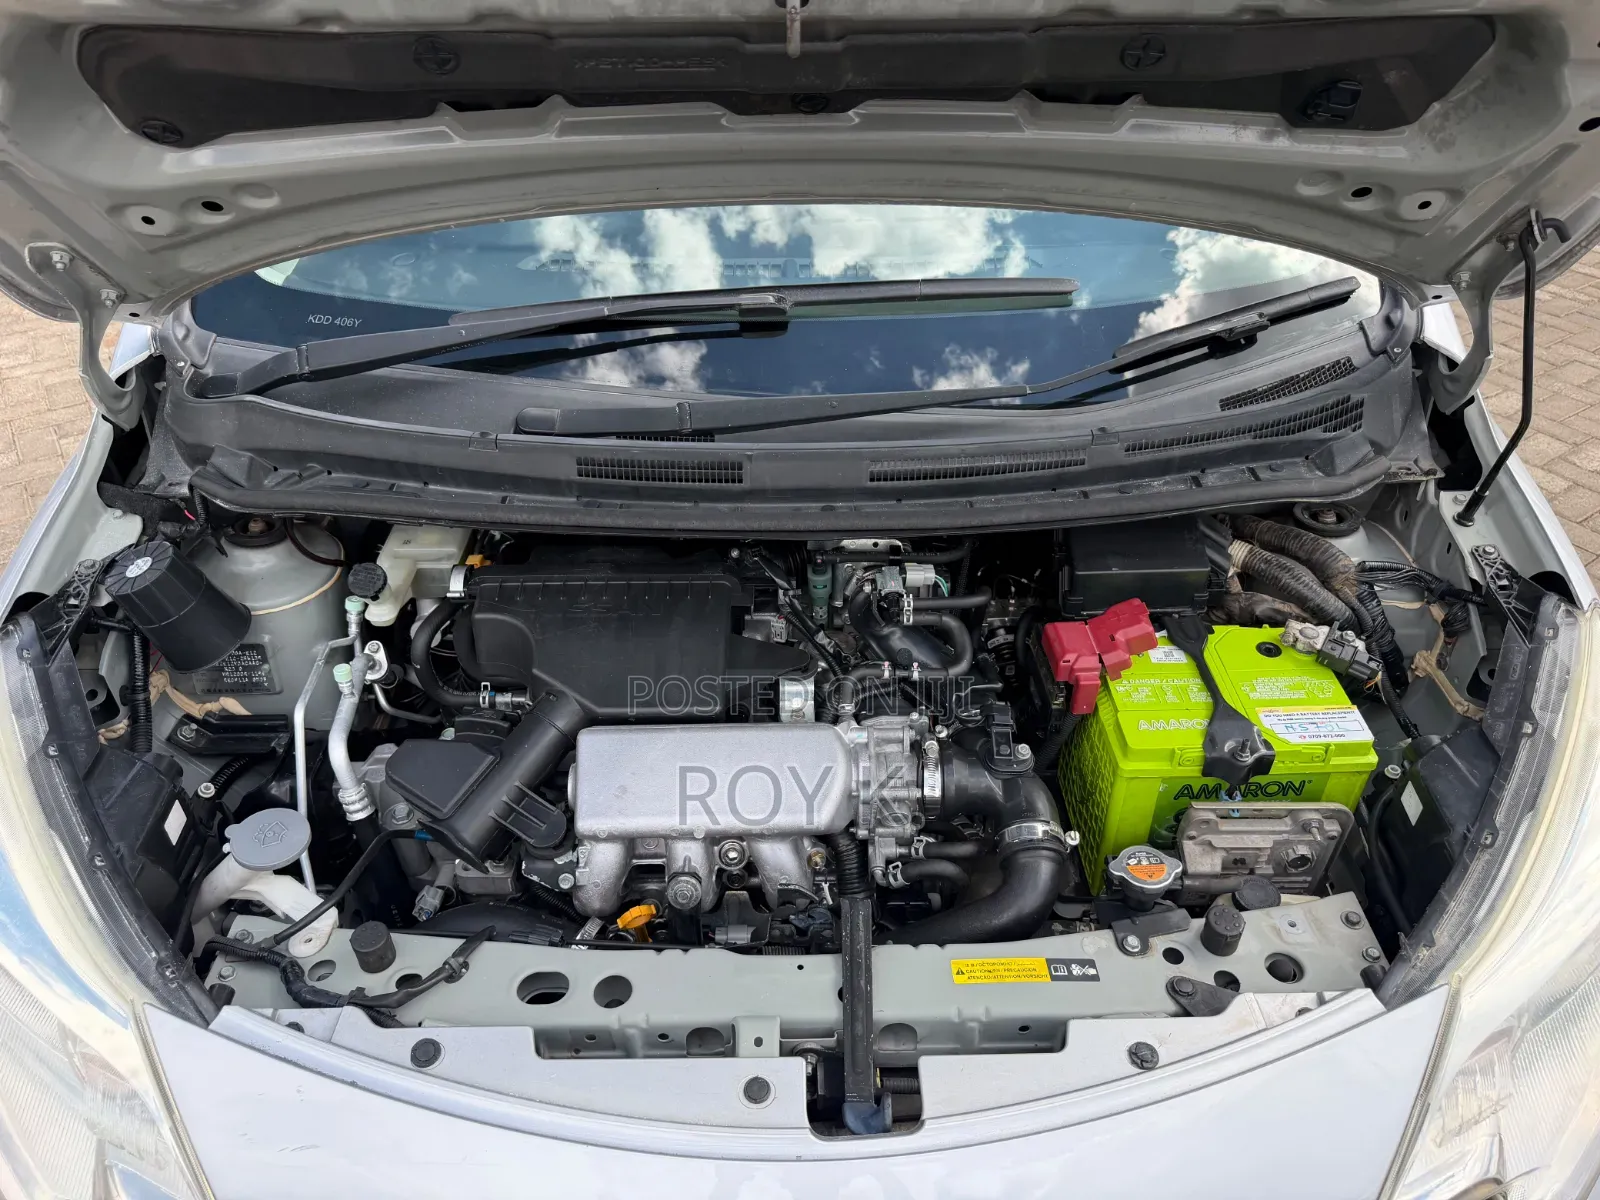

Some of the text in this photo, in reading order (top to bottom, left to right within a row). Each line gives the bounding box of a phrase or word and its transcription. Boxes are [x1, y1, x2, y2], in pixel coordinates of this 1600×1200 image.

[307, 314, 362, 327] KDD 406Y
[1138, 718, 1210, 731] AMARO
